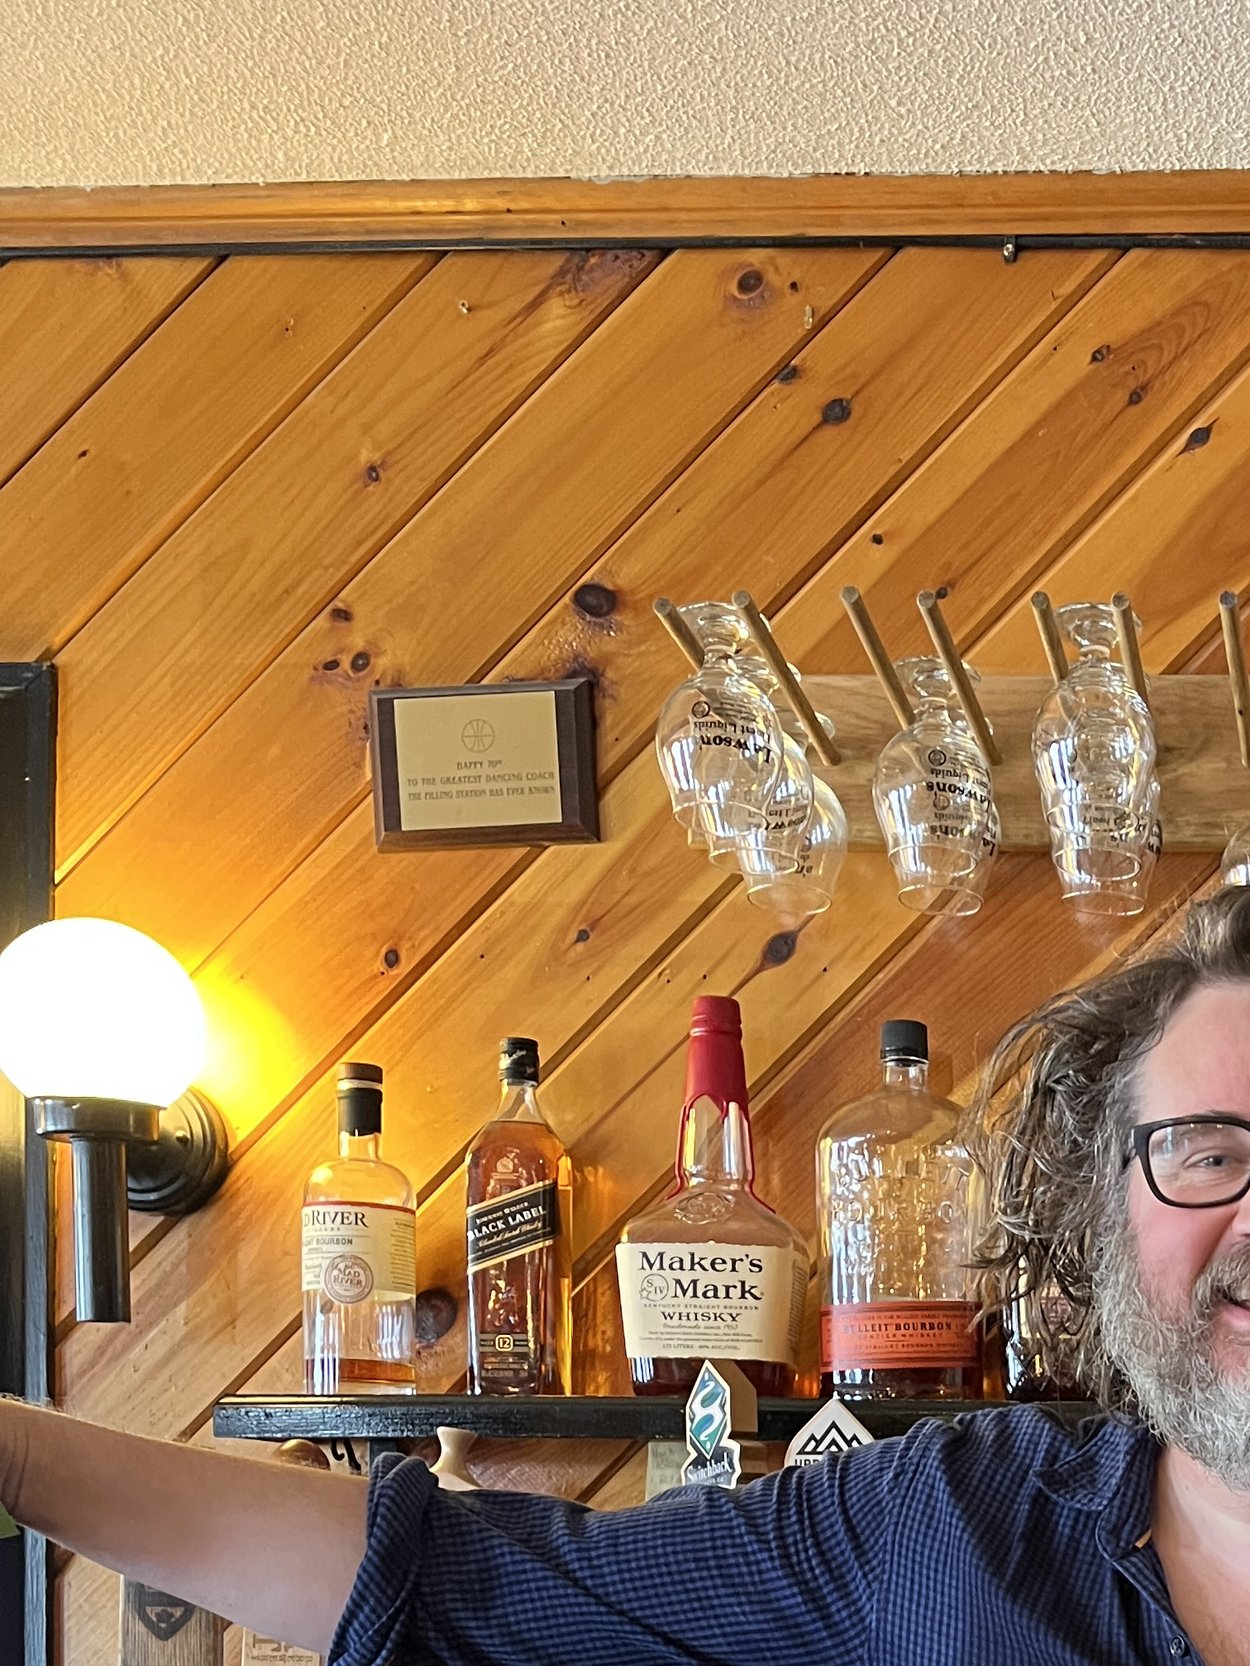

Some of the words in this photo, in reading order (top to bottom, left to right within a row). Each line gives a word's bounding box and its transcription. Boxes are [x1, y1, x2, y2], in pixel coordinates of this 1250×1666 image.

[407, 778, 419, 787] TO
[421, 777, 437, 787] THE
[311, 1209, 369, 1229] RIVER
[507, 1204, 548, 1225] LABEL
[638, 1250, 764, 1274] Maker's
[671, 1277, 763, 1301] Mark
[660, 1311, 743, 1322] WHISKY
[894, 1321, 953, 1332] BOURBON
[499, 1337, 511, 1348] 12
